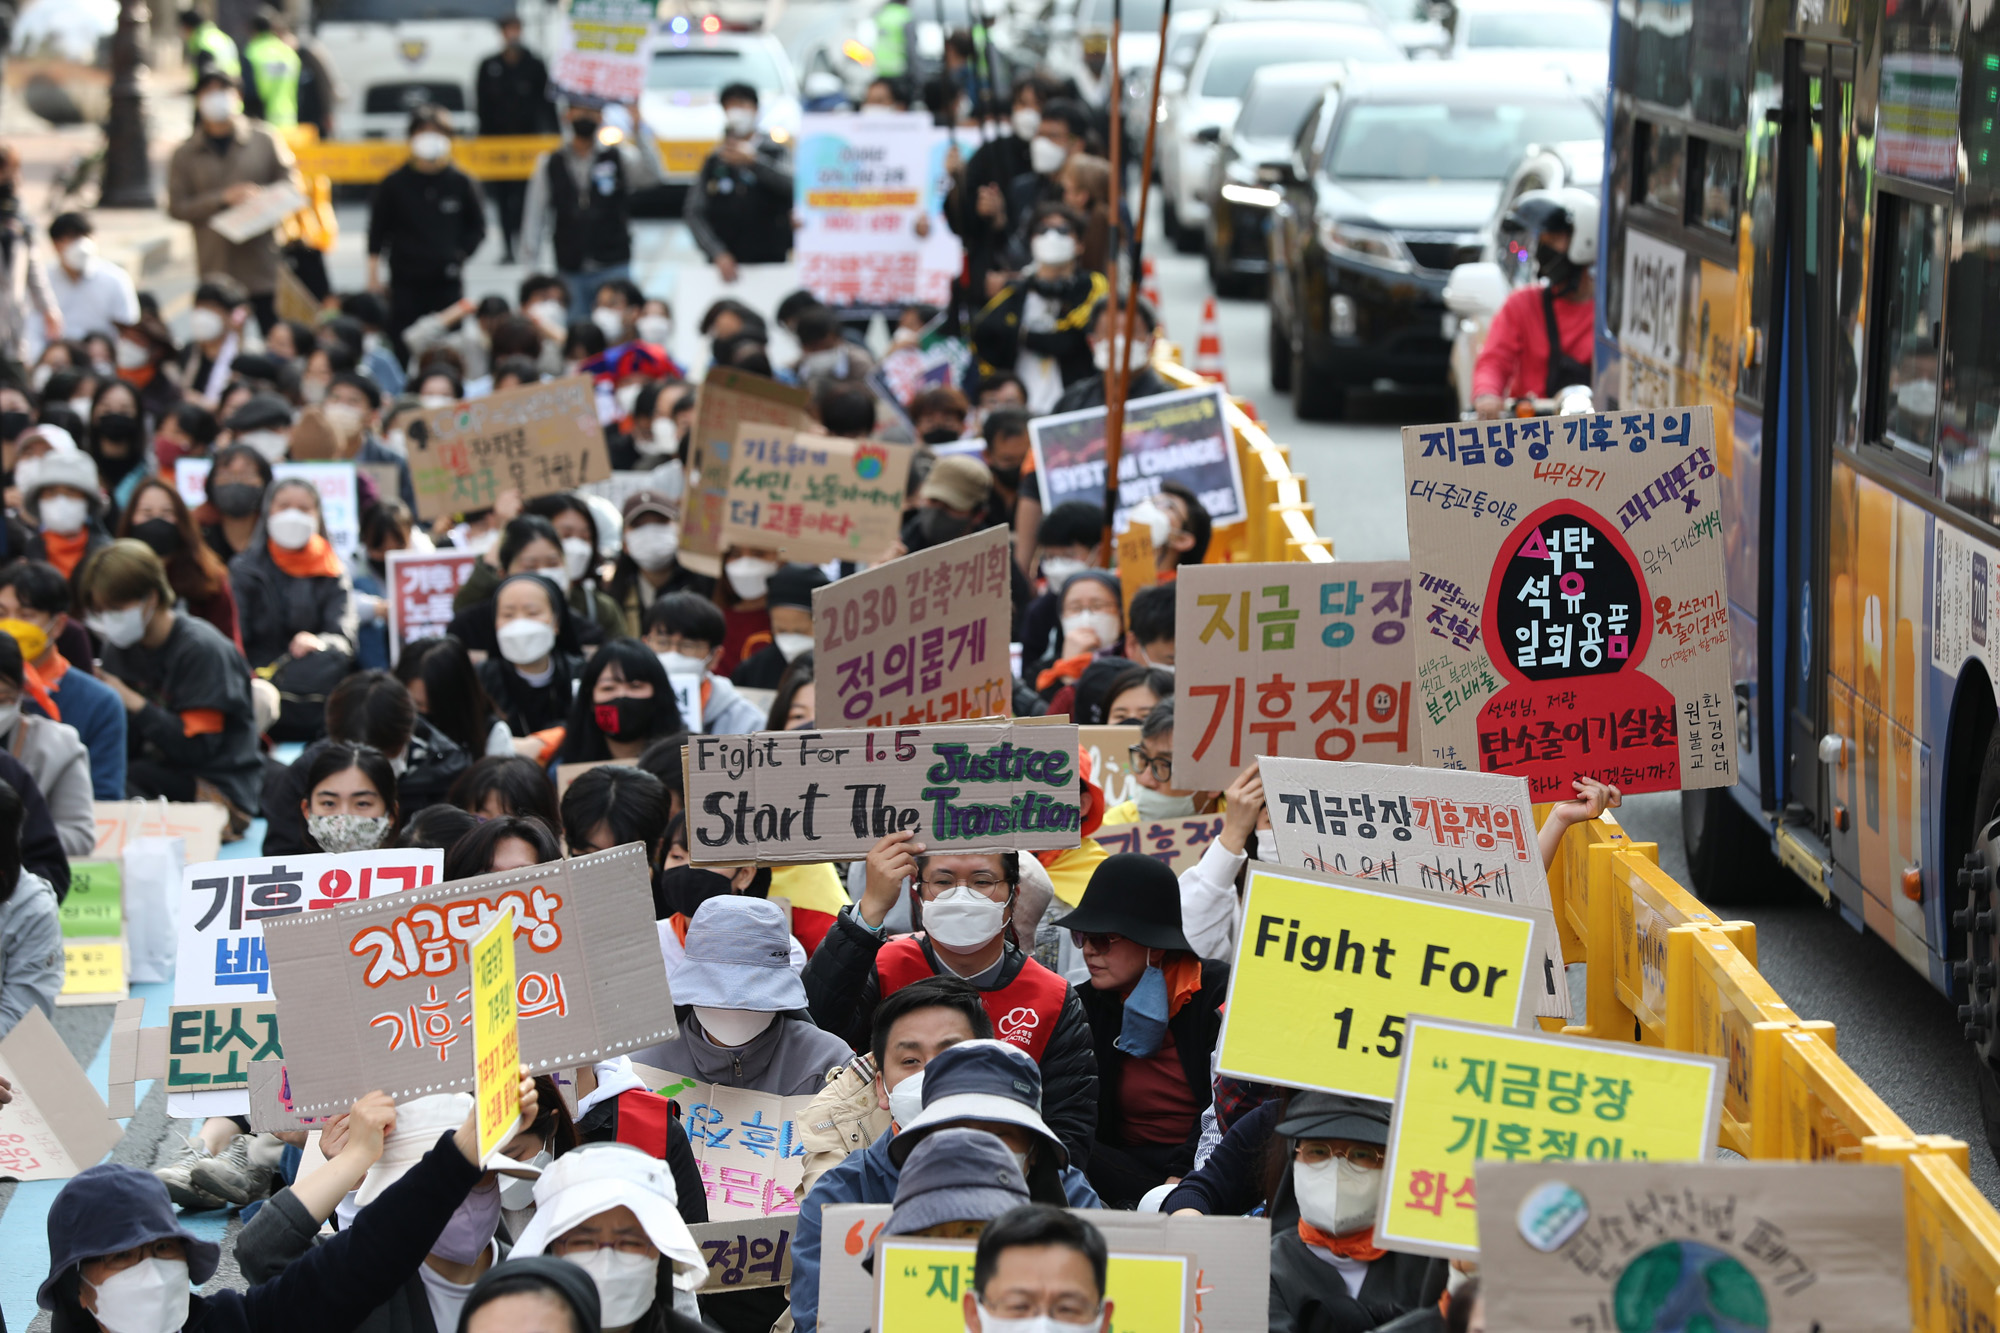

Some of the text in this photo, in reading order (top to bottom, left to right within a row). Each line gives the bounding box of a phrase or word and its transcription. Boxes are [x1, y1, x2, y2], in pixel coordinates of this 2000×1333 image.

[1050, 435, 1225, 494] SYSTM CHANGE
[1419, 420, 1554, 466] 지금당장
[1533, 461, 1606, 491] 나무심기
[1616, 446, 1716, 534] 과대포장
[821, 544, 1008, 652] 2030 감축계획
[1516, 571, 1586, 620] 석유
[1654, 595, 1676, 636] 옷
[1677, 590, 1721, 619] 쓰레기
[1973, 580, 1985, 624] 710
[1426, 604, 1482, 652] 전환
[1515, 604, 1630, 669] 일회용품
[836, 616, 988, 721] 정의롭게
[1418, 655, 1454, 678] 비우고
[1420, 675, 1446, 698] 씻고
[1188, 673, 1412, 768] 기후정의
[1426, 670, 1499, 726] 분리배출
[1487, 691, 1577, 719] 선생님, 저랑
[696, 729, 922, 781] Fight For 1.5
[926, 741, 1074, 787] Justice
[1432, 746, 1458, 761] 기후
[1530, 776, 1562, 795] 하나
[696, 782, 922, 848] Start The
[921, 786, 1081, 842] Transition
[350, 885, 563, 989] 지금당장
[1254, 914, 1508, 998] Fight For
[1637, 922, 1668, 995] POLIC
[369, 971, 568, 1062] 기후의
[1009, 1035, 1031, 1046] ACTION
[1333, 1007, 1405, 1059] 1.5
[701, 1229, 790, 1285] 정의
